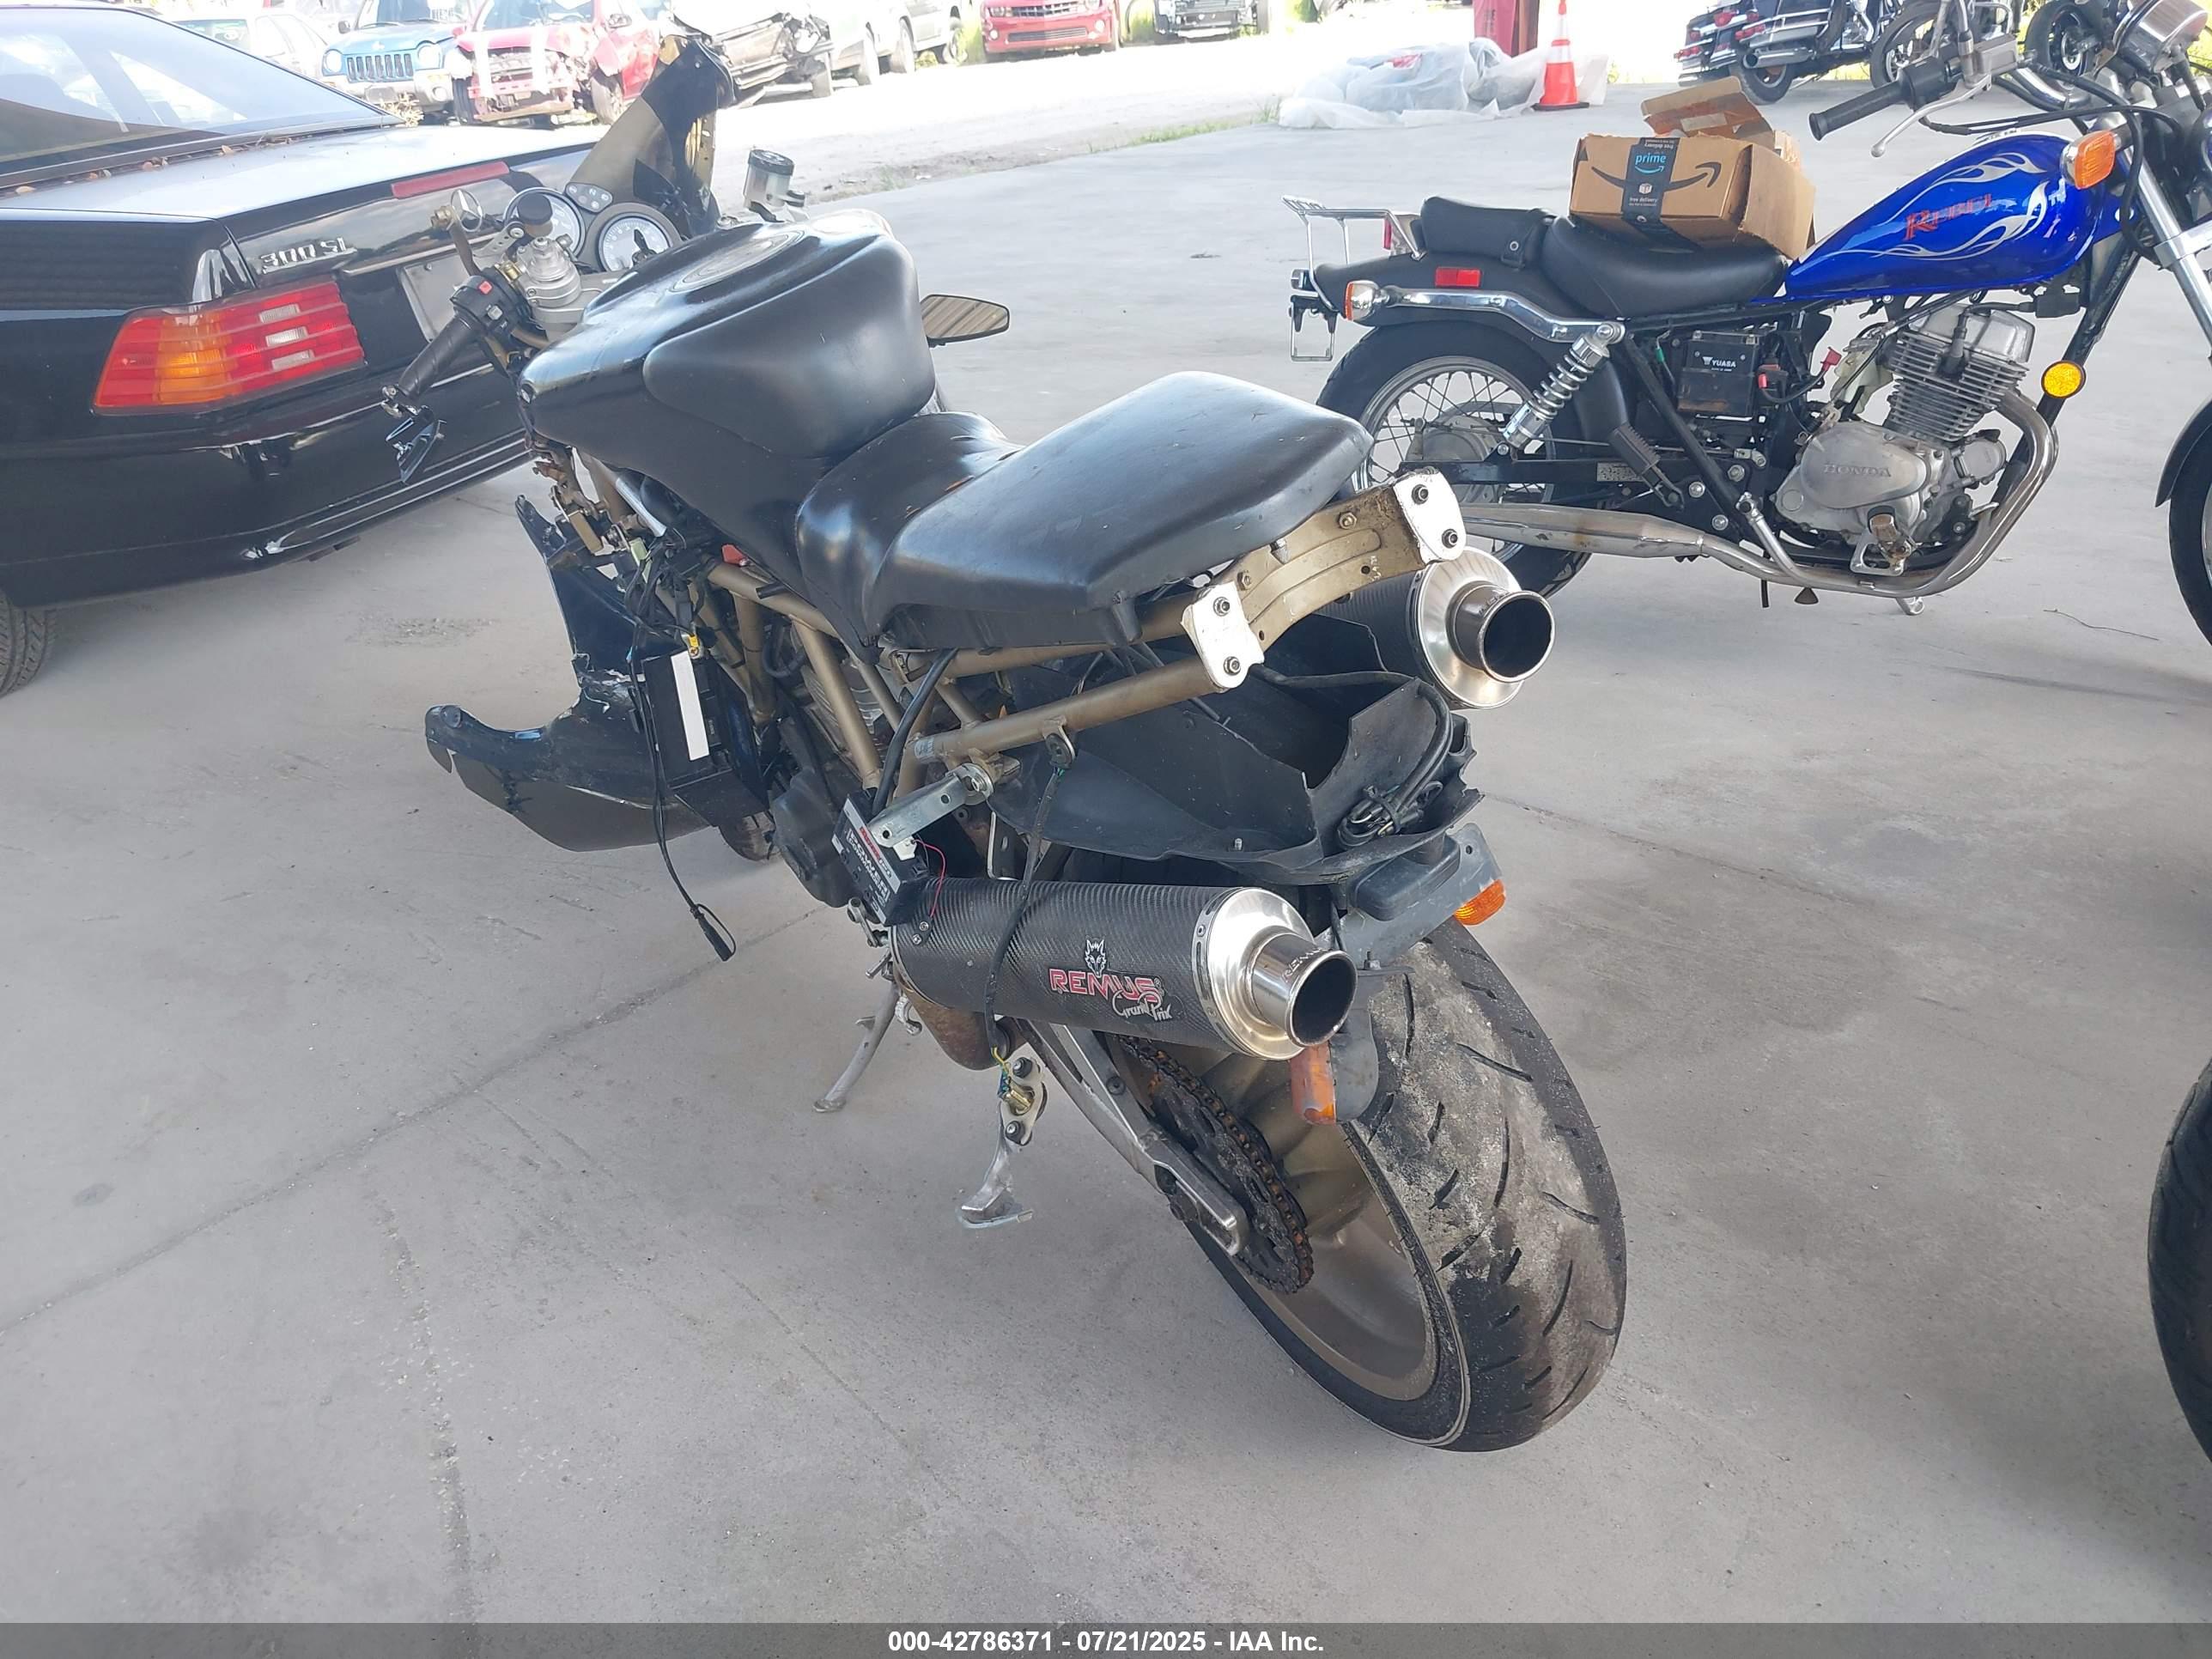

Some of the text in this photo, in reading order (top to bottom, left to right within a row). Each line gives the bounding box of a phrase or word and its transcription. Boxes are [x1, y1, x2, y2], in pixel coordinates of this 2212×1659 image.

[1635, 152, 1667, 165] prime
[260, 237, 357, 270] 300 SL
[1823, 465, 1892, 477] HONDA
[850, 830, 888, 894] POWER
[1282, 948, 1331, 982] REM
[1048, 968, 1159, 1003] REMUS
[1138, 991, 1173, 1021] Prix
